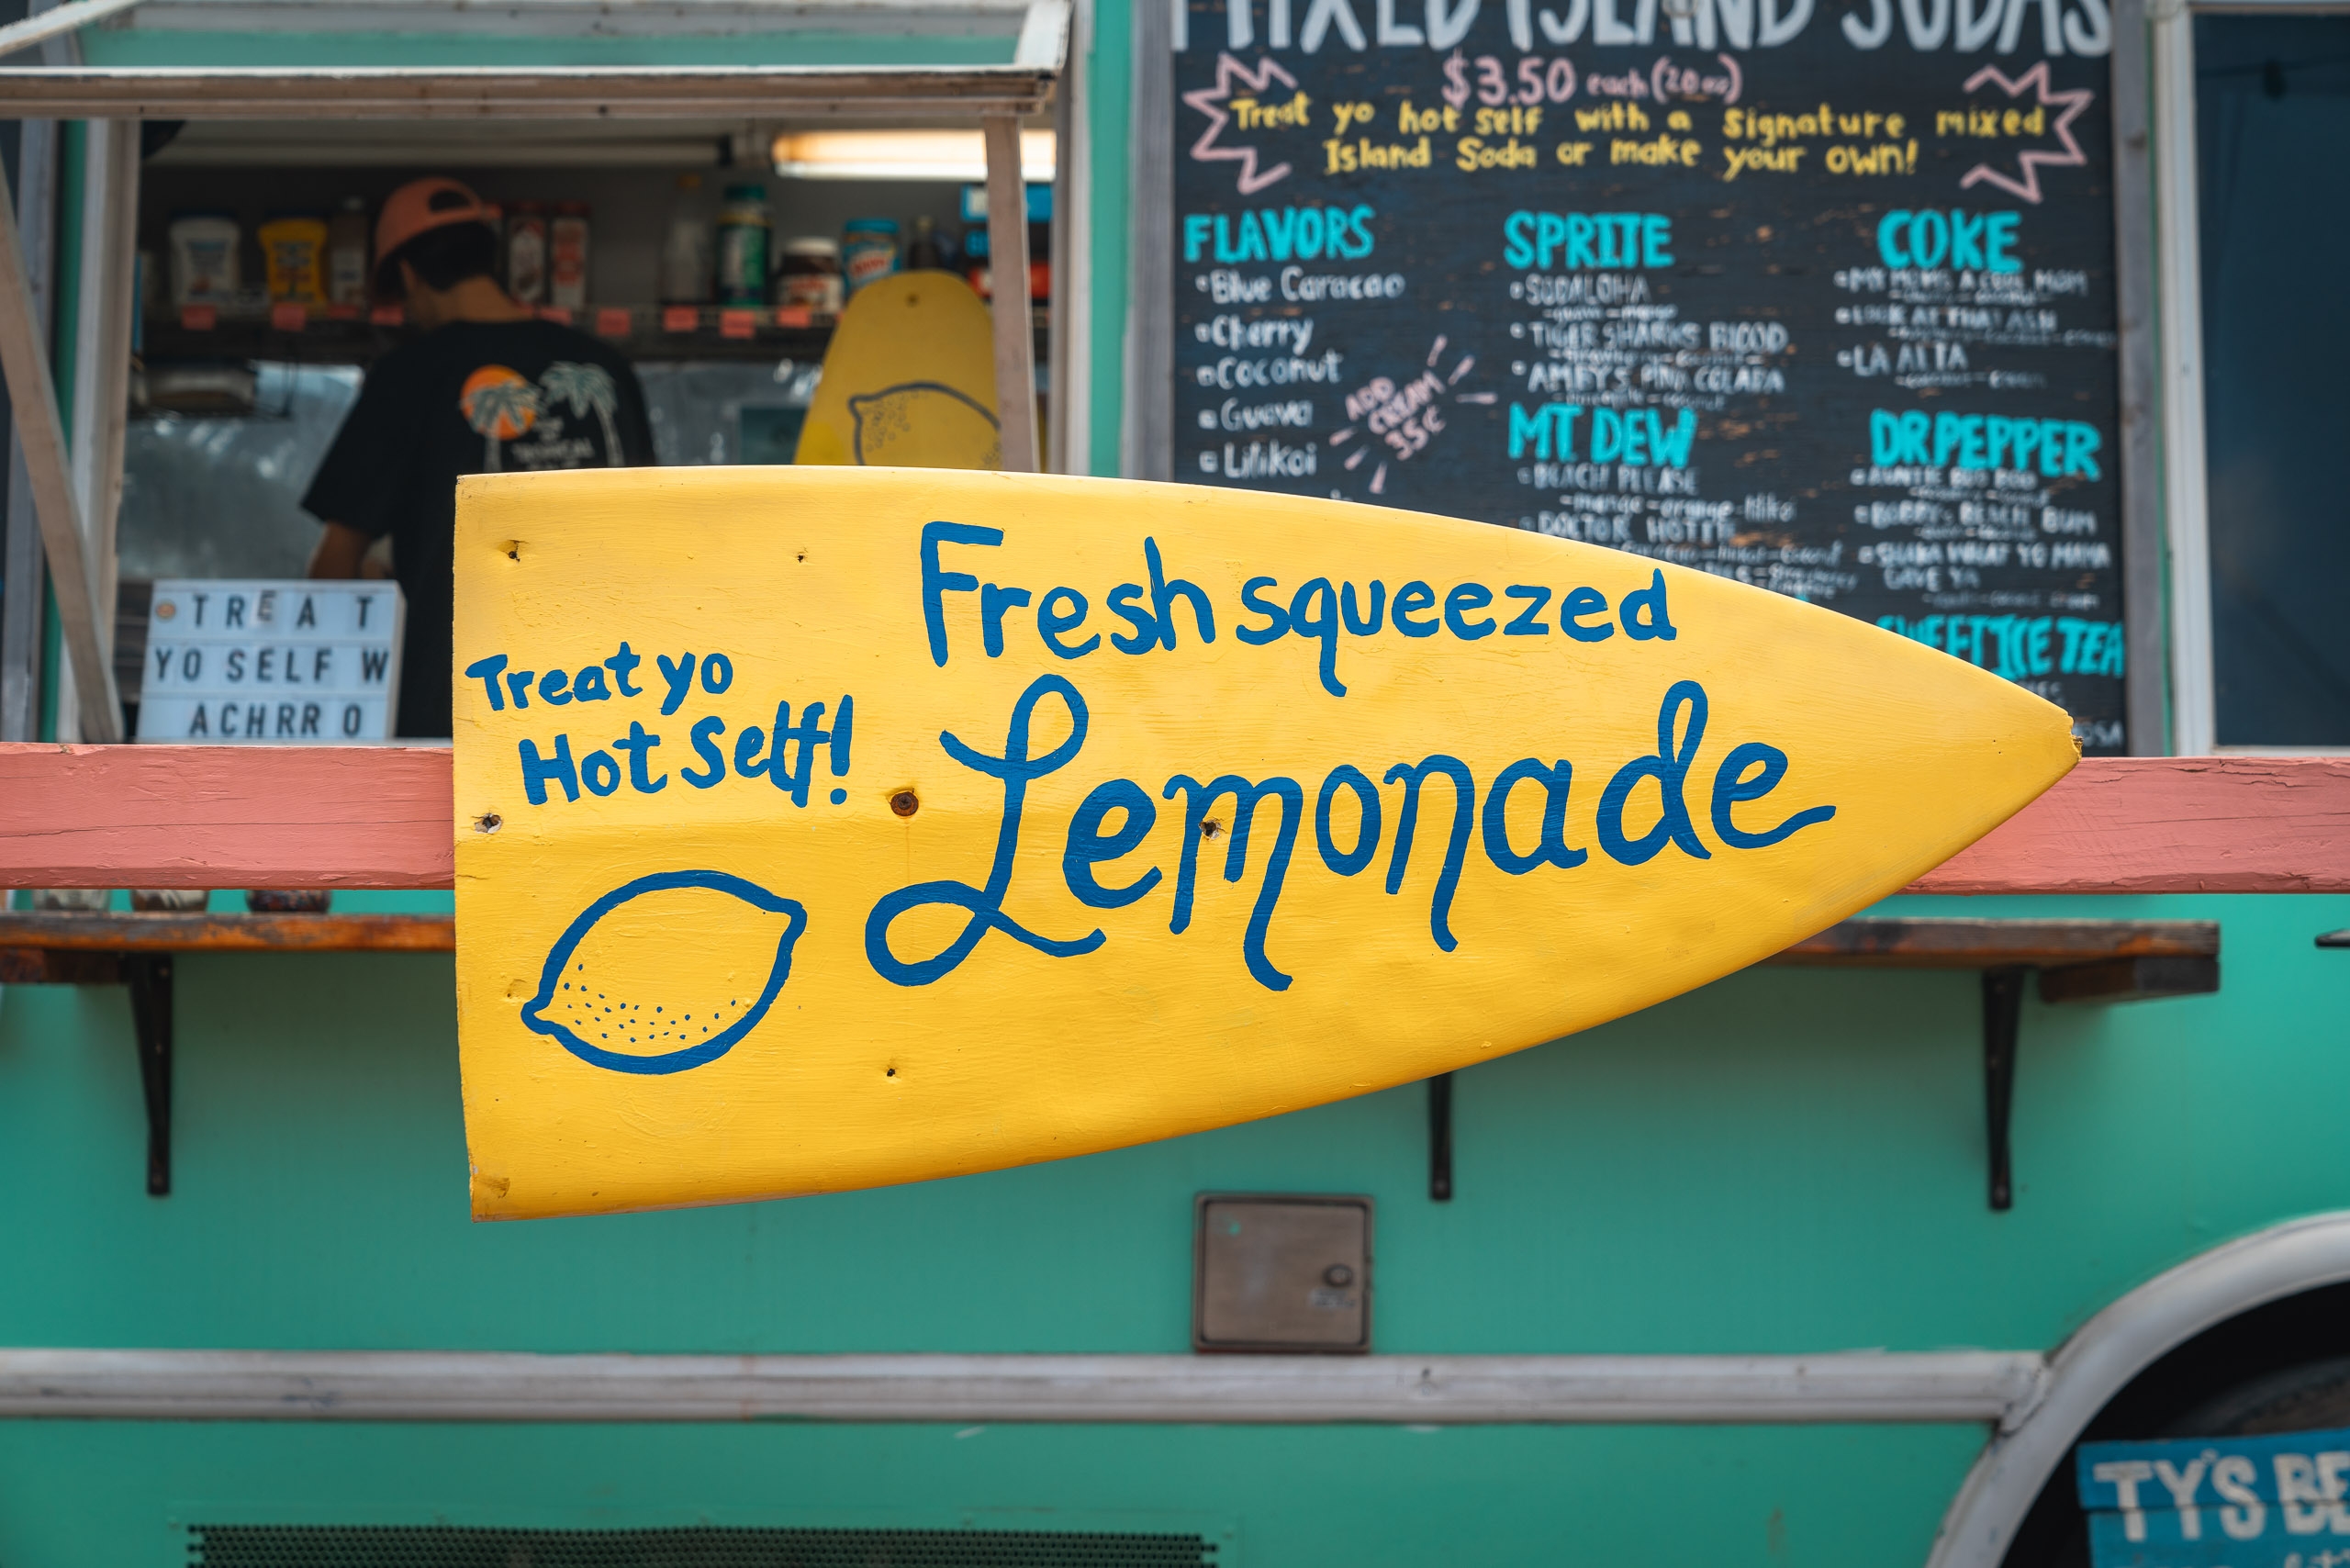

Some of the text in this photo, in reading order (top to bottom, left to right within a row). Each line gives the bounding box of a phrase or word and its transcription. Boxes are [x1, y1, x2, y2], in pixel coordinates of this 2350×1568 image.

[1442, 53, 1577, 108] $3.50
[1586, 67, 1650, 99] each
[1230, 90, 1312, 130] Treat
[1332, 101, 1375, 135] yo
[1398, 100, 1460, 135] hot
[1575, 101, 1650, 132] with
[1668, 109, 1692, 131] a
[1936, 104, 2046, 137] mixed
[1323, 133, 1919, 182] Island Soda or make your own!
[1182, 205, 1374, 264] FLAVORS
[1503, 210, 1674, 270] SPRITE
[1876, 207, 2025, 274] COKE
[1209, 268, 1272, 305] Blue
[1525, 273, 1653, 306] SODALOHA
[1211, 314, 1315, 356] Cherry
[1528, 321, 1600, 349] TIGER
[1708, 322, 1789, 354] BLOOD
[1217, 348, 1343, 390] Coconut
[1220, 398, 1315, 431] Guava
[1590, 407, 1697, 469] DEW
[1224, 440, 1317, 479] Lilikoi
[1869, 408, 2101, 482] DR PEPPER
[920, 521, 1678, 698] Fresh squeezed
[154, 646, 389, 683] YO SELF W
[464, 641, 733, 716] Treat yo
[518, 694, 854, 809] Hot Self!
[866, 675, 1837, 992] Lemonade
[2092, 1447, 2266, 1543] TY'S
